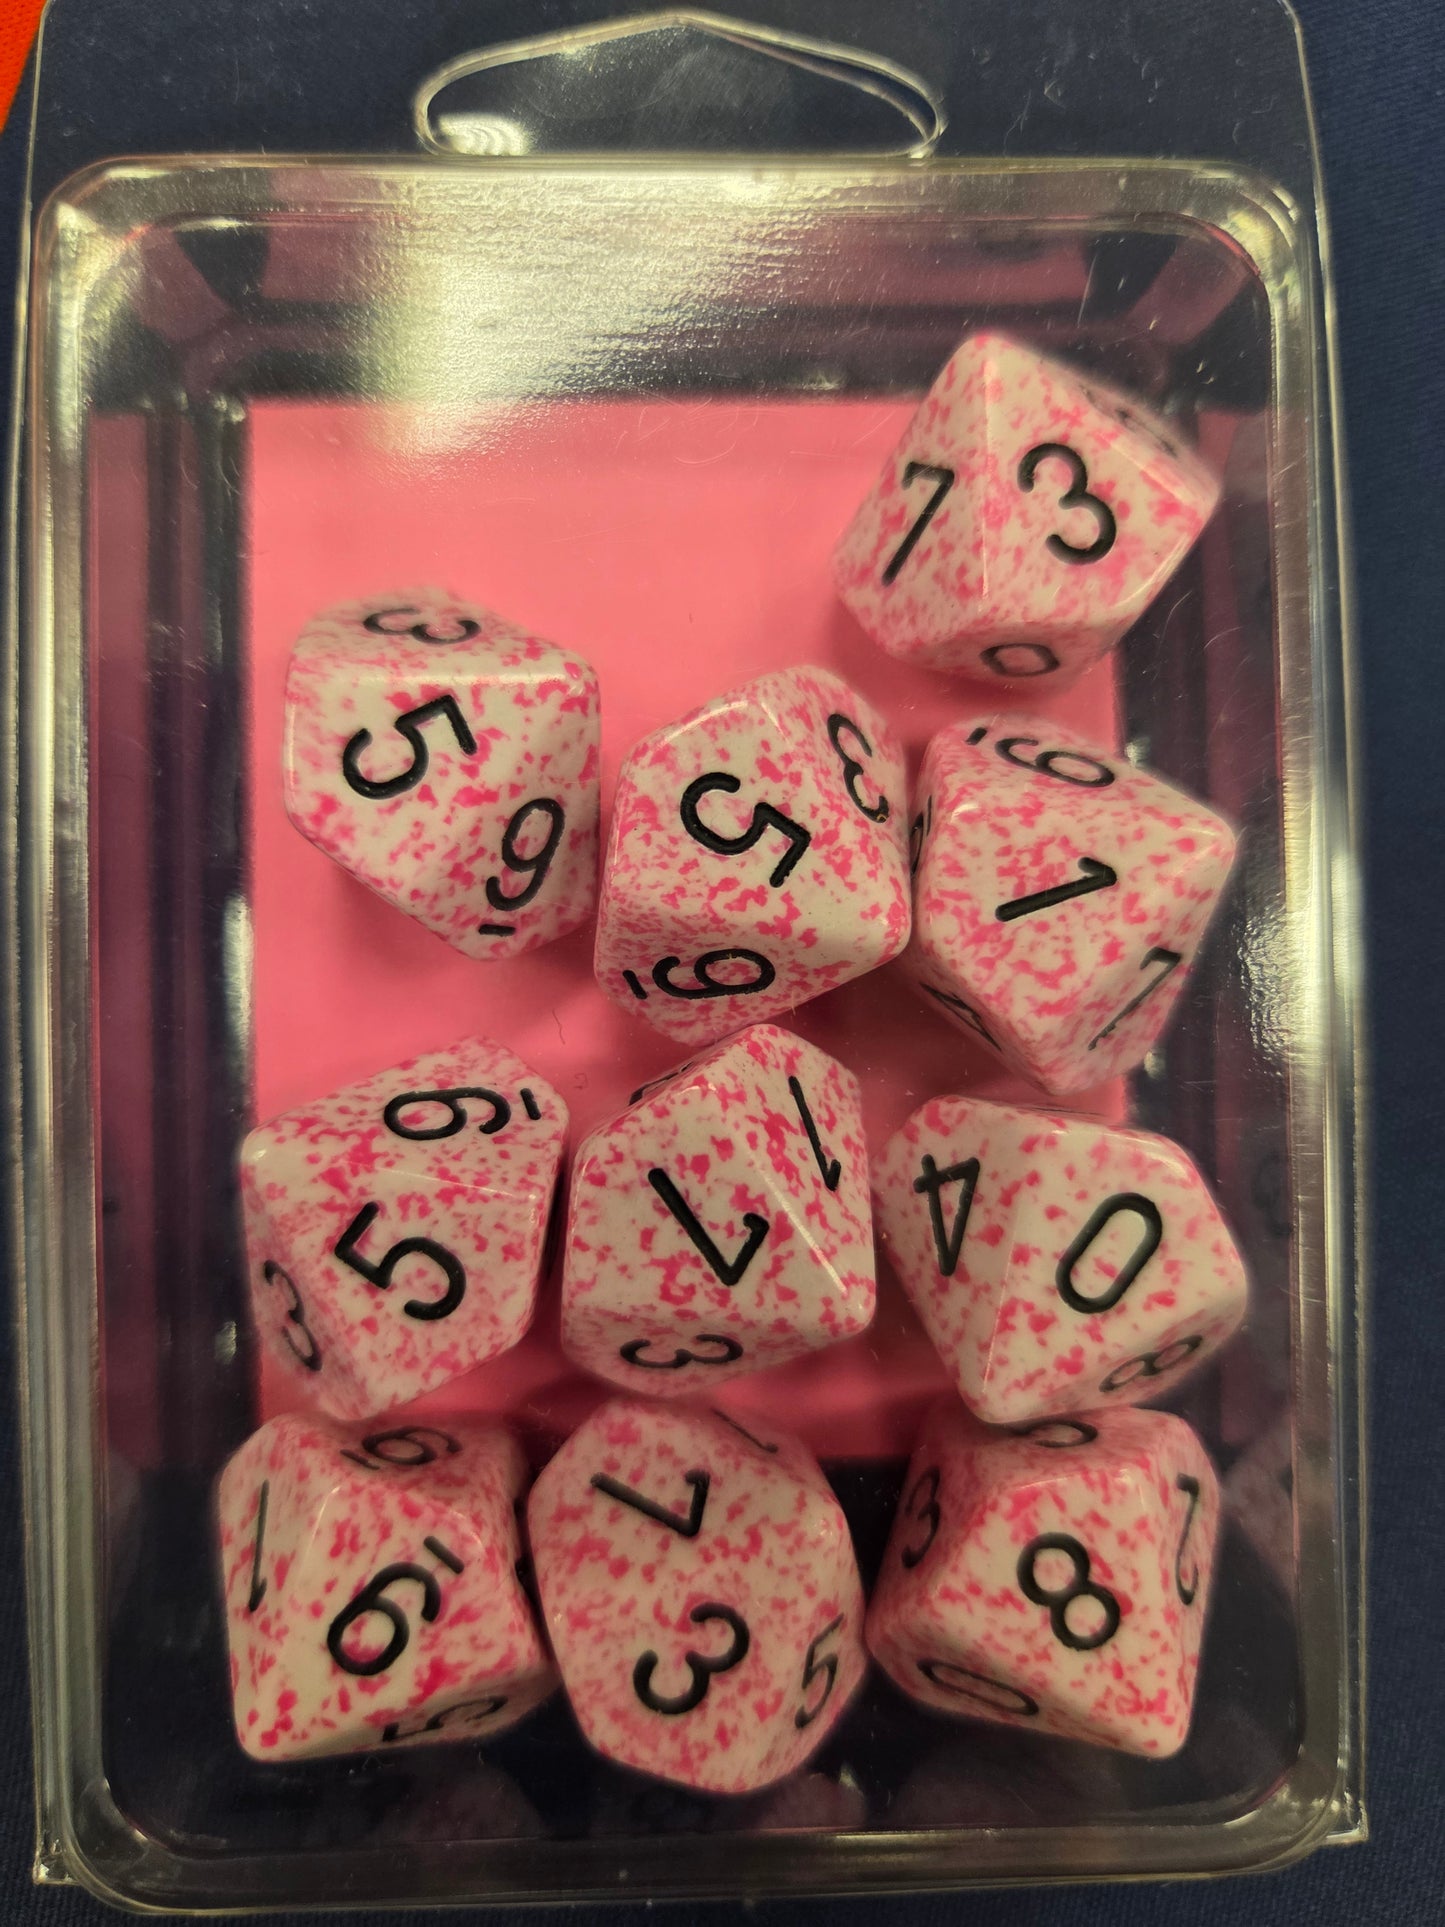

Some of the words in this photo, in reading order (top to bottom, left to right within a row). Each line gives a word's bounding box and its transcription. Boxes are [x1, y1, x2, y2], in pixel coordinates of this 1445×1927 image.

[882, 461, 954, 586] 7
[1017, 442, 1117, 565] 3
[363, 607, 482, 645] 3
[980, 642, 1060, 677] 0
[342, 694, 477, 800] 5
[827, 713, 890, 823] 3
[478, 798, 565, 937] 9
[680, 771, 812, 888] 5
[995, 856, 1117, 922] 1
[789, 1075, 842, 1192] 1
[334, 1201, 467, 1321] 5
[648, 1167, 770, 1286] 7
[913, 1154, 980, 1277] 4
[1055, 1192, 1163, 1314] 0
[264, 1259, 323, 1371] 3
[619, 1333, 744, 1369] 3
[1099, 1335, 1203, 1392] 8
[590, 1468, 710, 1537] 7
[1016, 1531, 1122, 1652] 8
[632, 1602, 750, 1715] 3
[794, 1613, 845, 1729] 5
